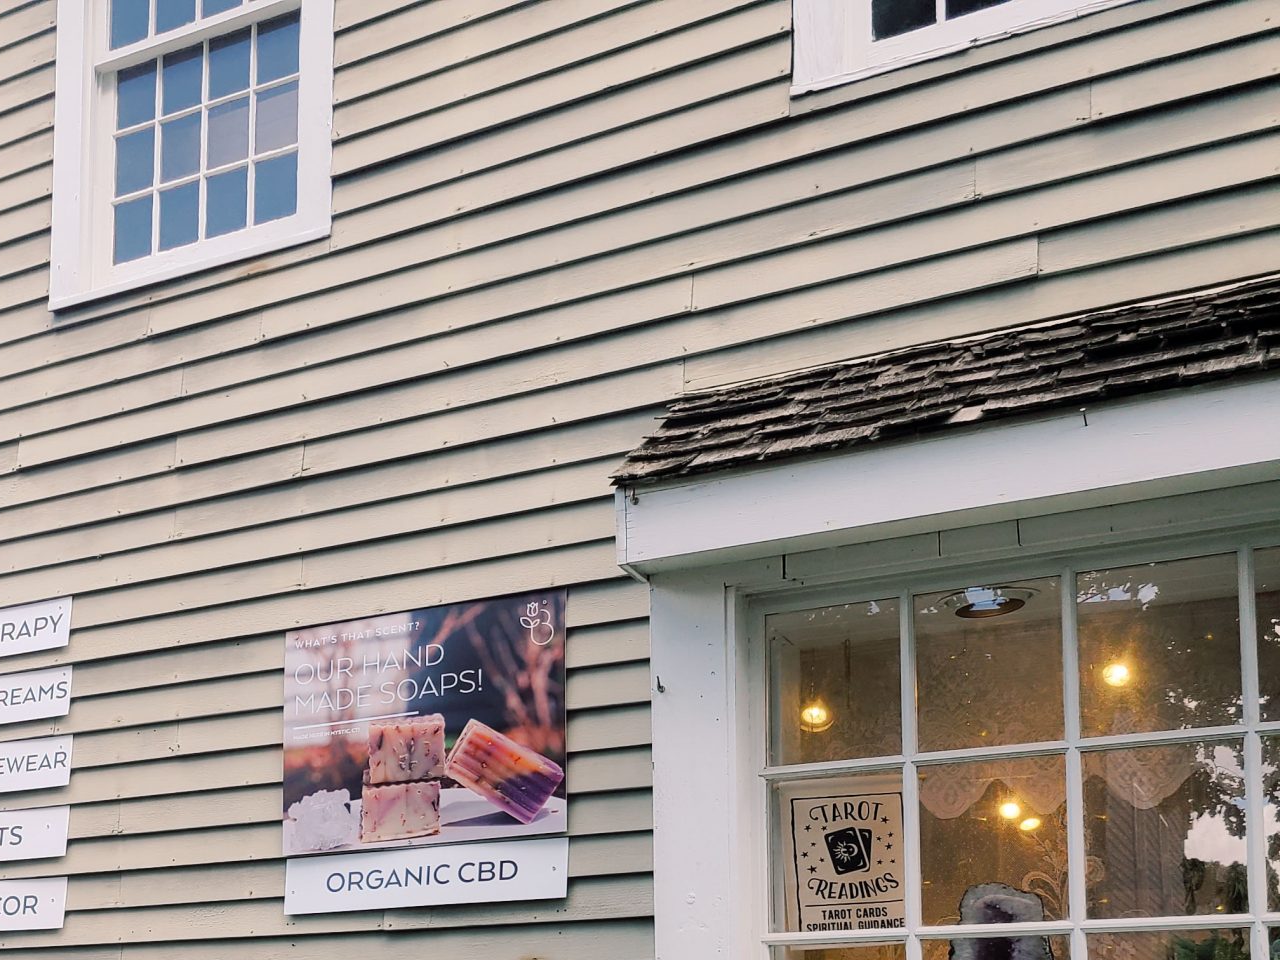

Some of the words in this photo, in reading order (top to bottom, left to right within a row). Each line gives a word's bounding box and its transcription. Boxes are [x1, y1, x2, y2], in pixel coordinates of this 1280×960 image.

[295, 635, 338, 649] WHAT'S
[341, 630, 371, 642] THAT
[375, 621, 420, 637] SCENT?
[294, 657, 353, 685] OUR
[362, 643, 445, 676] HAND
[295, 684, 372, 715] MADE
[380, 668, 483, 704] SOAPS!
[809, 800, 884, 823] TAROT
[326, 863, 451, 893] ORGANIC
[457, 860, 519, 884] CBD
[807, 872, 899, 900] READINGS
[806, 921, 853, 932] SPIRITUAL
[858, 917, 906, 930] GUIDANCE
[821, 908, 853, 921] TAROT
[856, 907, 888, 919] CARDS
